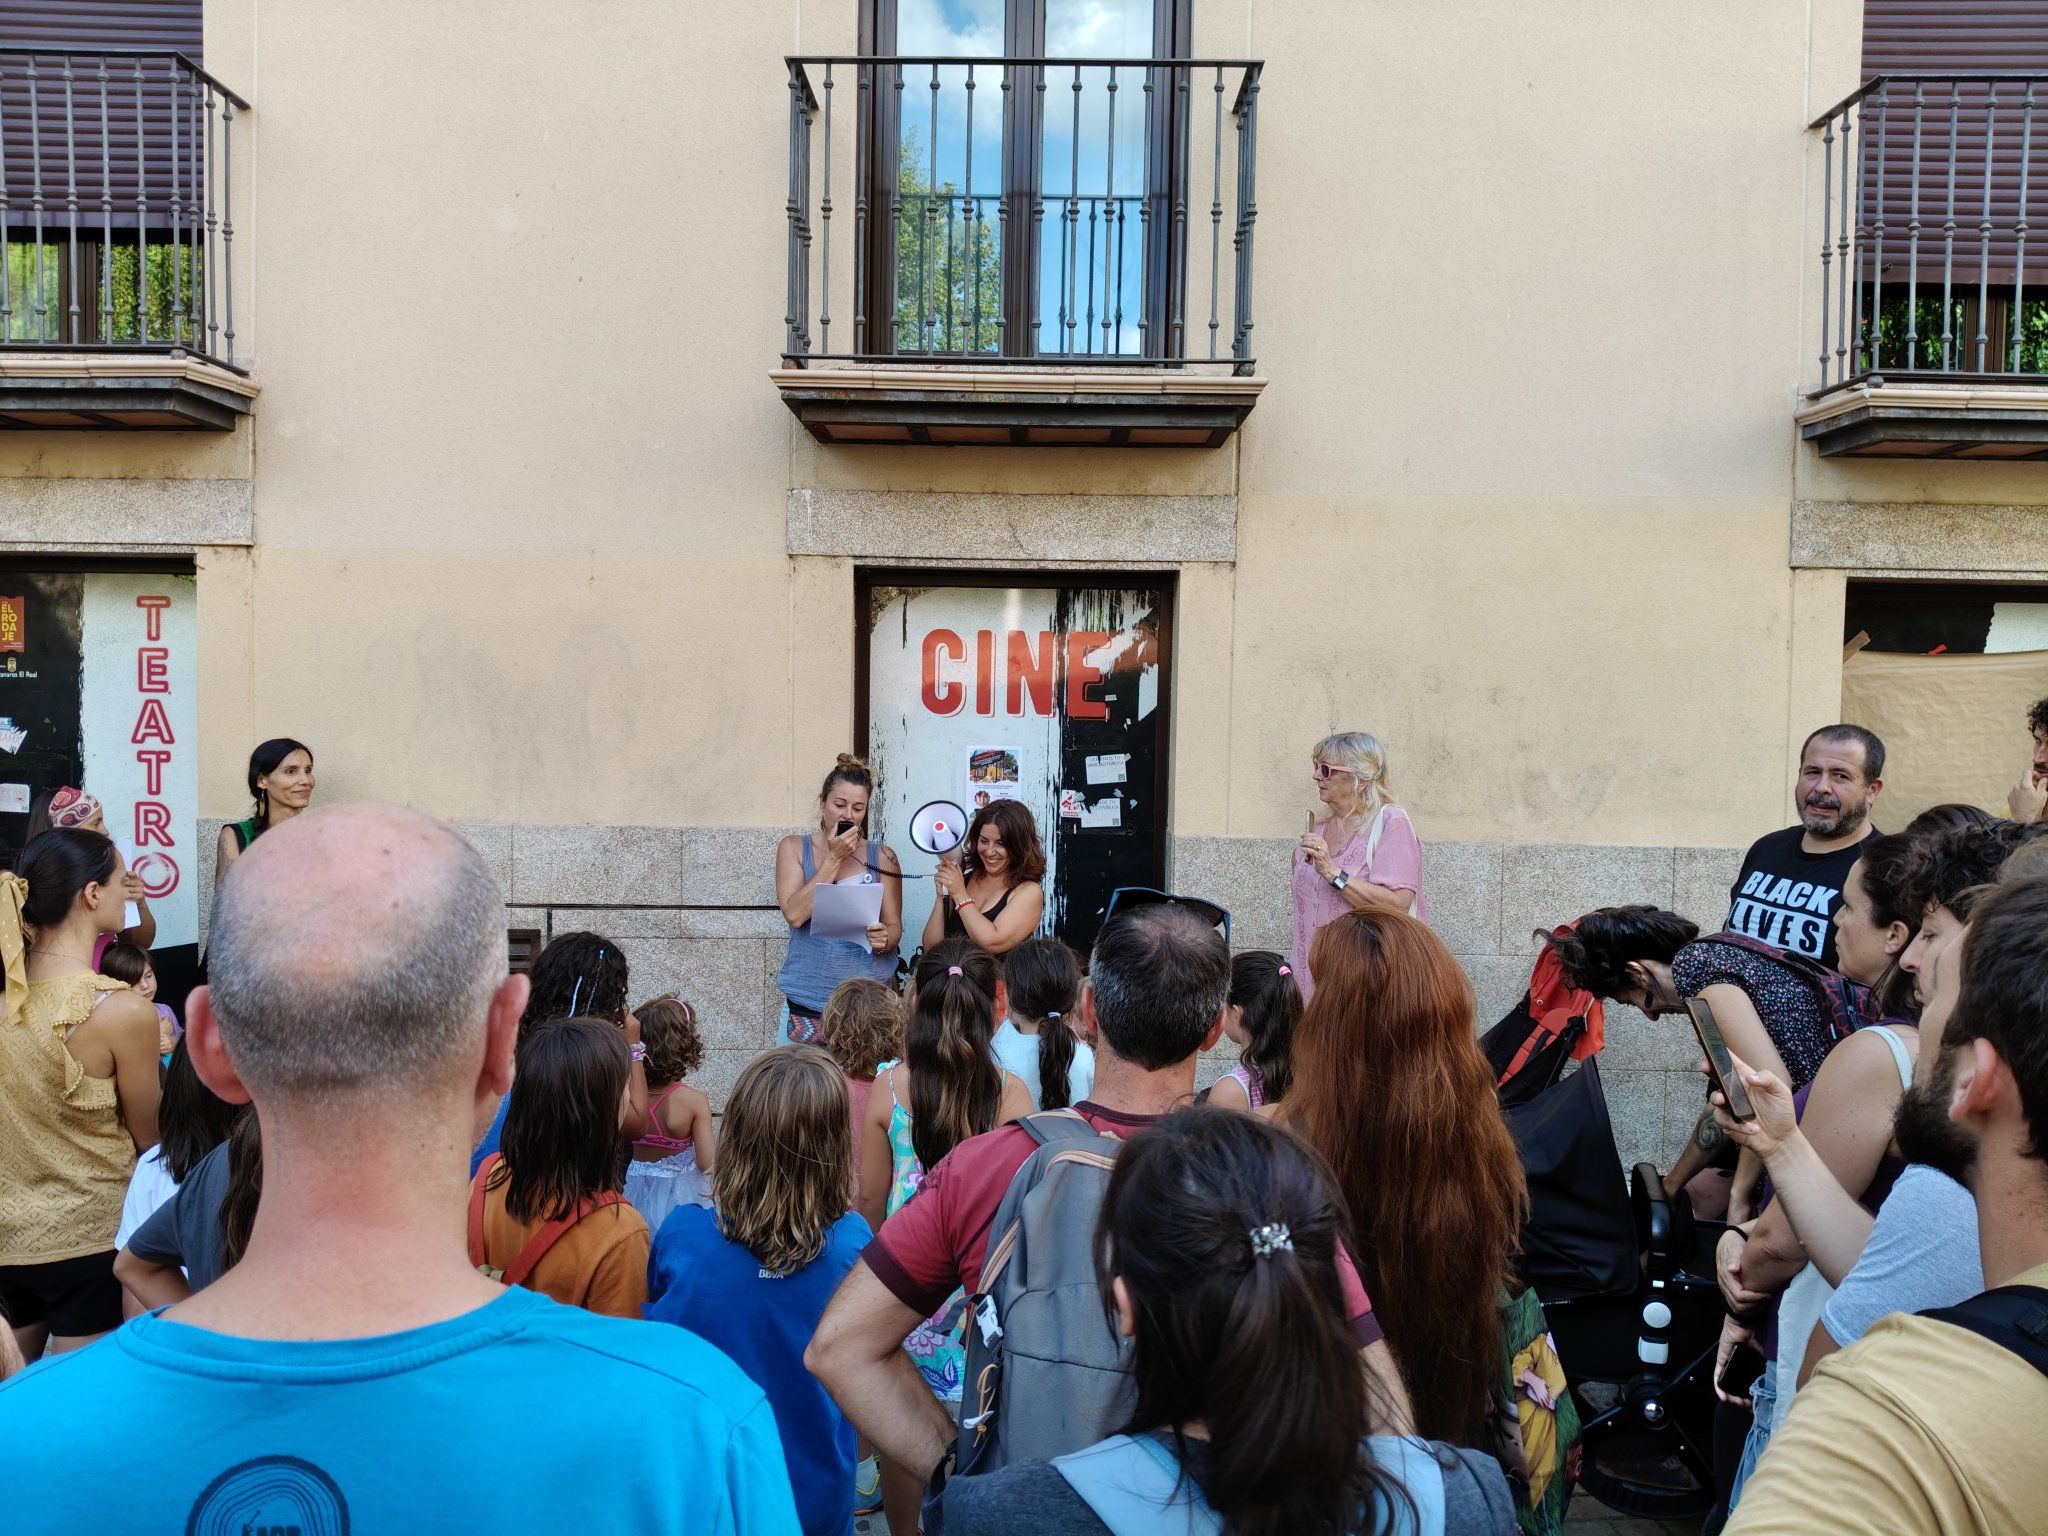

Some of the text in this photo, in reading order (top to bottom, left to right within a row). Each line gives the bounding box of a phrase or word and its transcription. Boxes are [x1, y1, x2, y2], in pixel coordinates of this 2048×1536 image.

[1, 604, 13, 613] EL
[1, 613, 18, 623] RO
[1, 623, 17, 632] DA
[2, 632, 15, 641] JE
[921, 628, 1112, 721] CINE
[131, 595, 180, 899] TEATRO
[1740, 871, 1839, 915] BLACK
[1728, 900, 1821, 954] LIVES
